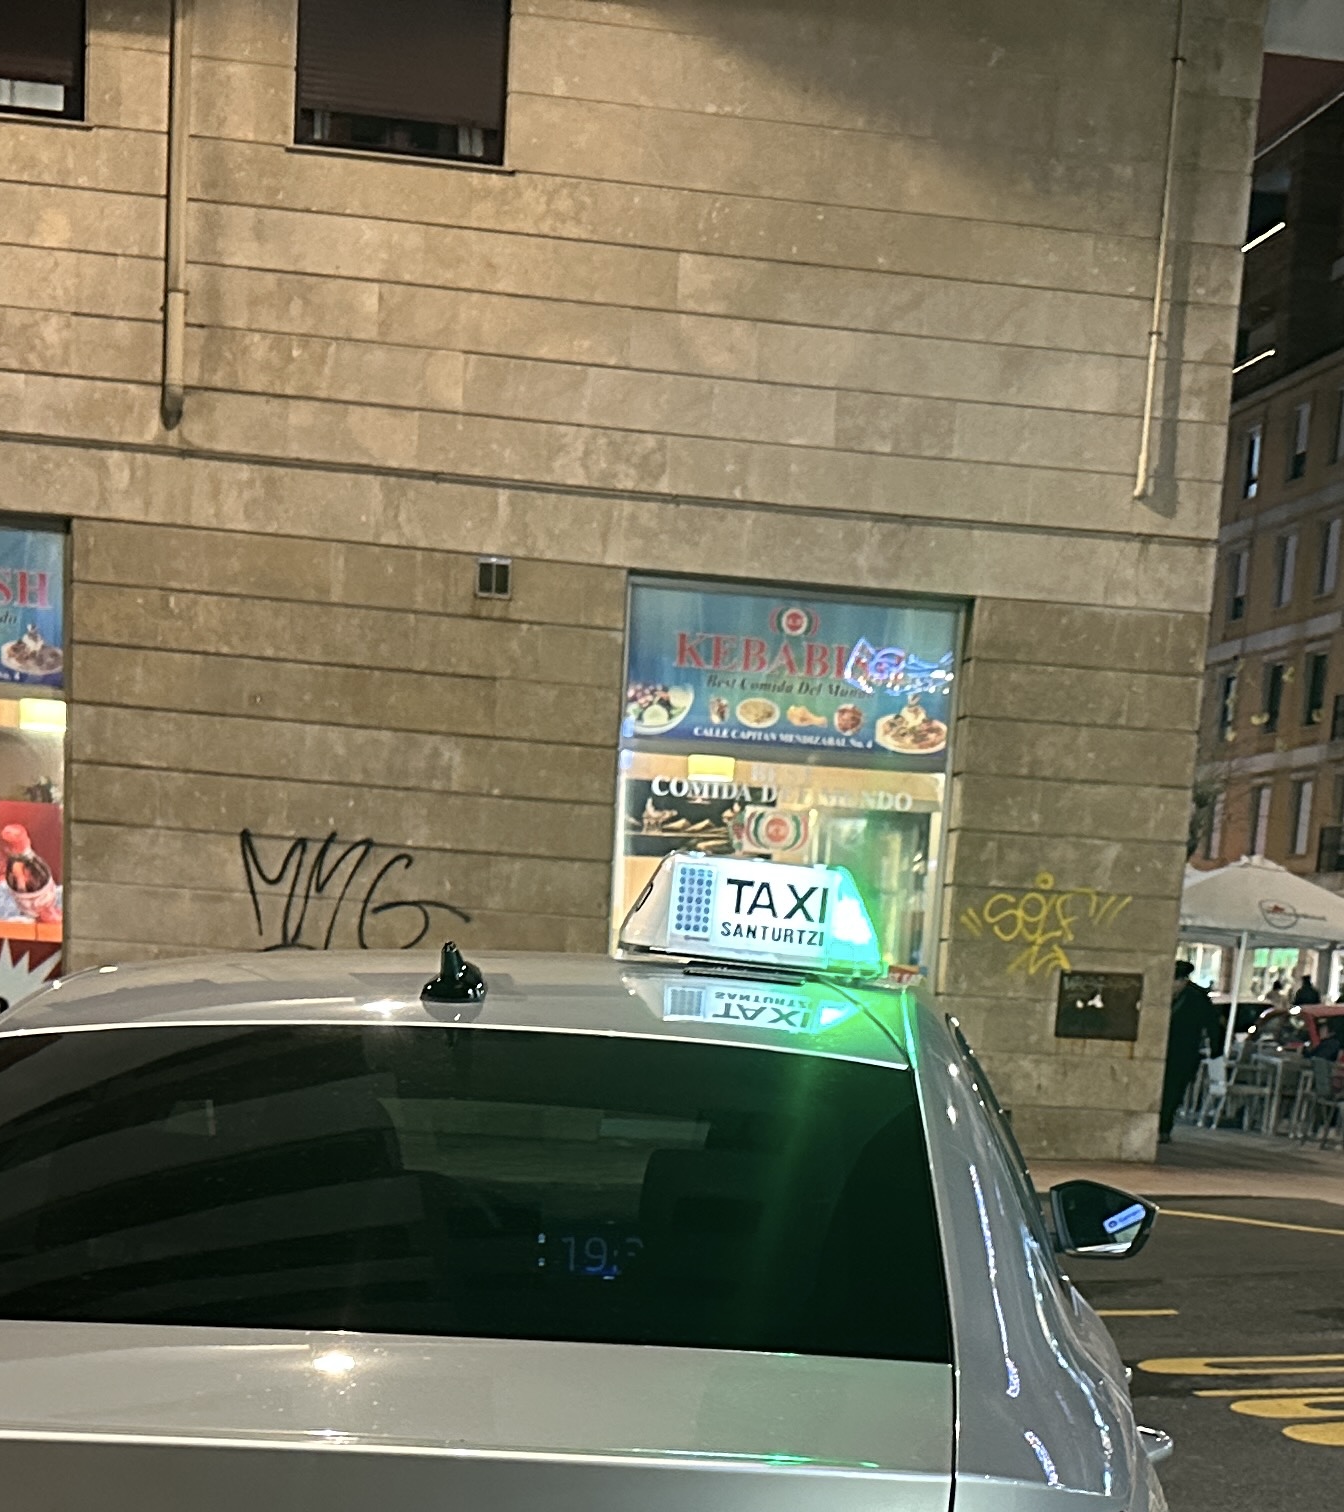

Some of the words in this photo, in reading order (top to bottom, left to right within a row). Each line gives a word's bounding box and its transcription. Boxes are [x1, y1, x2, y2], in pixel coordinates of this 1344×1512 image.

[674, 632, 904, 684] KEBABI
[707, 674, 736, 688] Best
[740, 677, 793, 694] Comida
[798, 680, 822, 695] Del
[693, 726, 730, 739] CALLE
[732, 728, 777, 743] CAPITAN
[651, 775, 752, 802] COMIDA
[726, 878, 829, 924] TAXI
[720, 921, 824, 947] SANTURTZI
